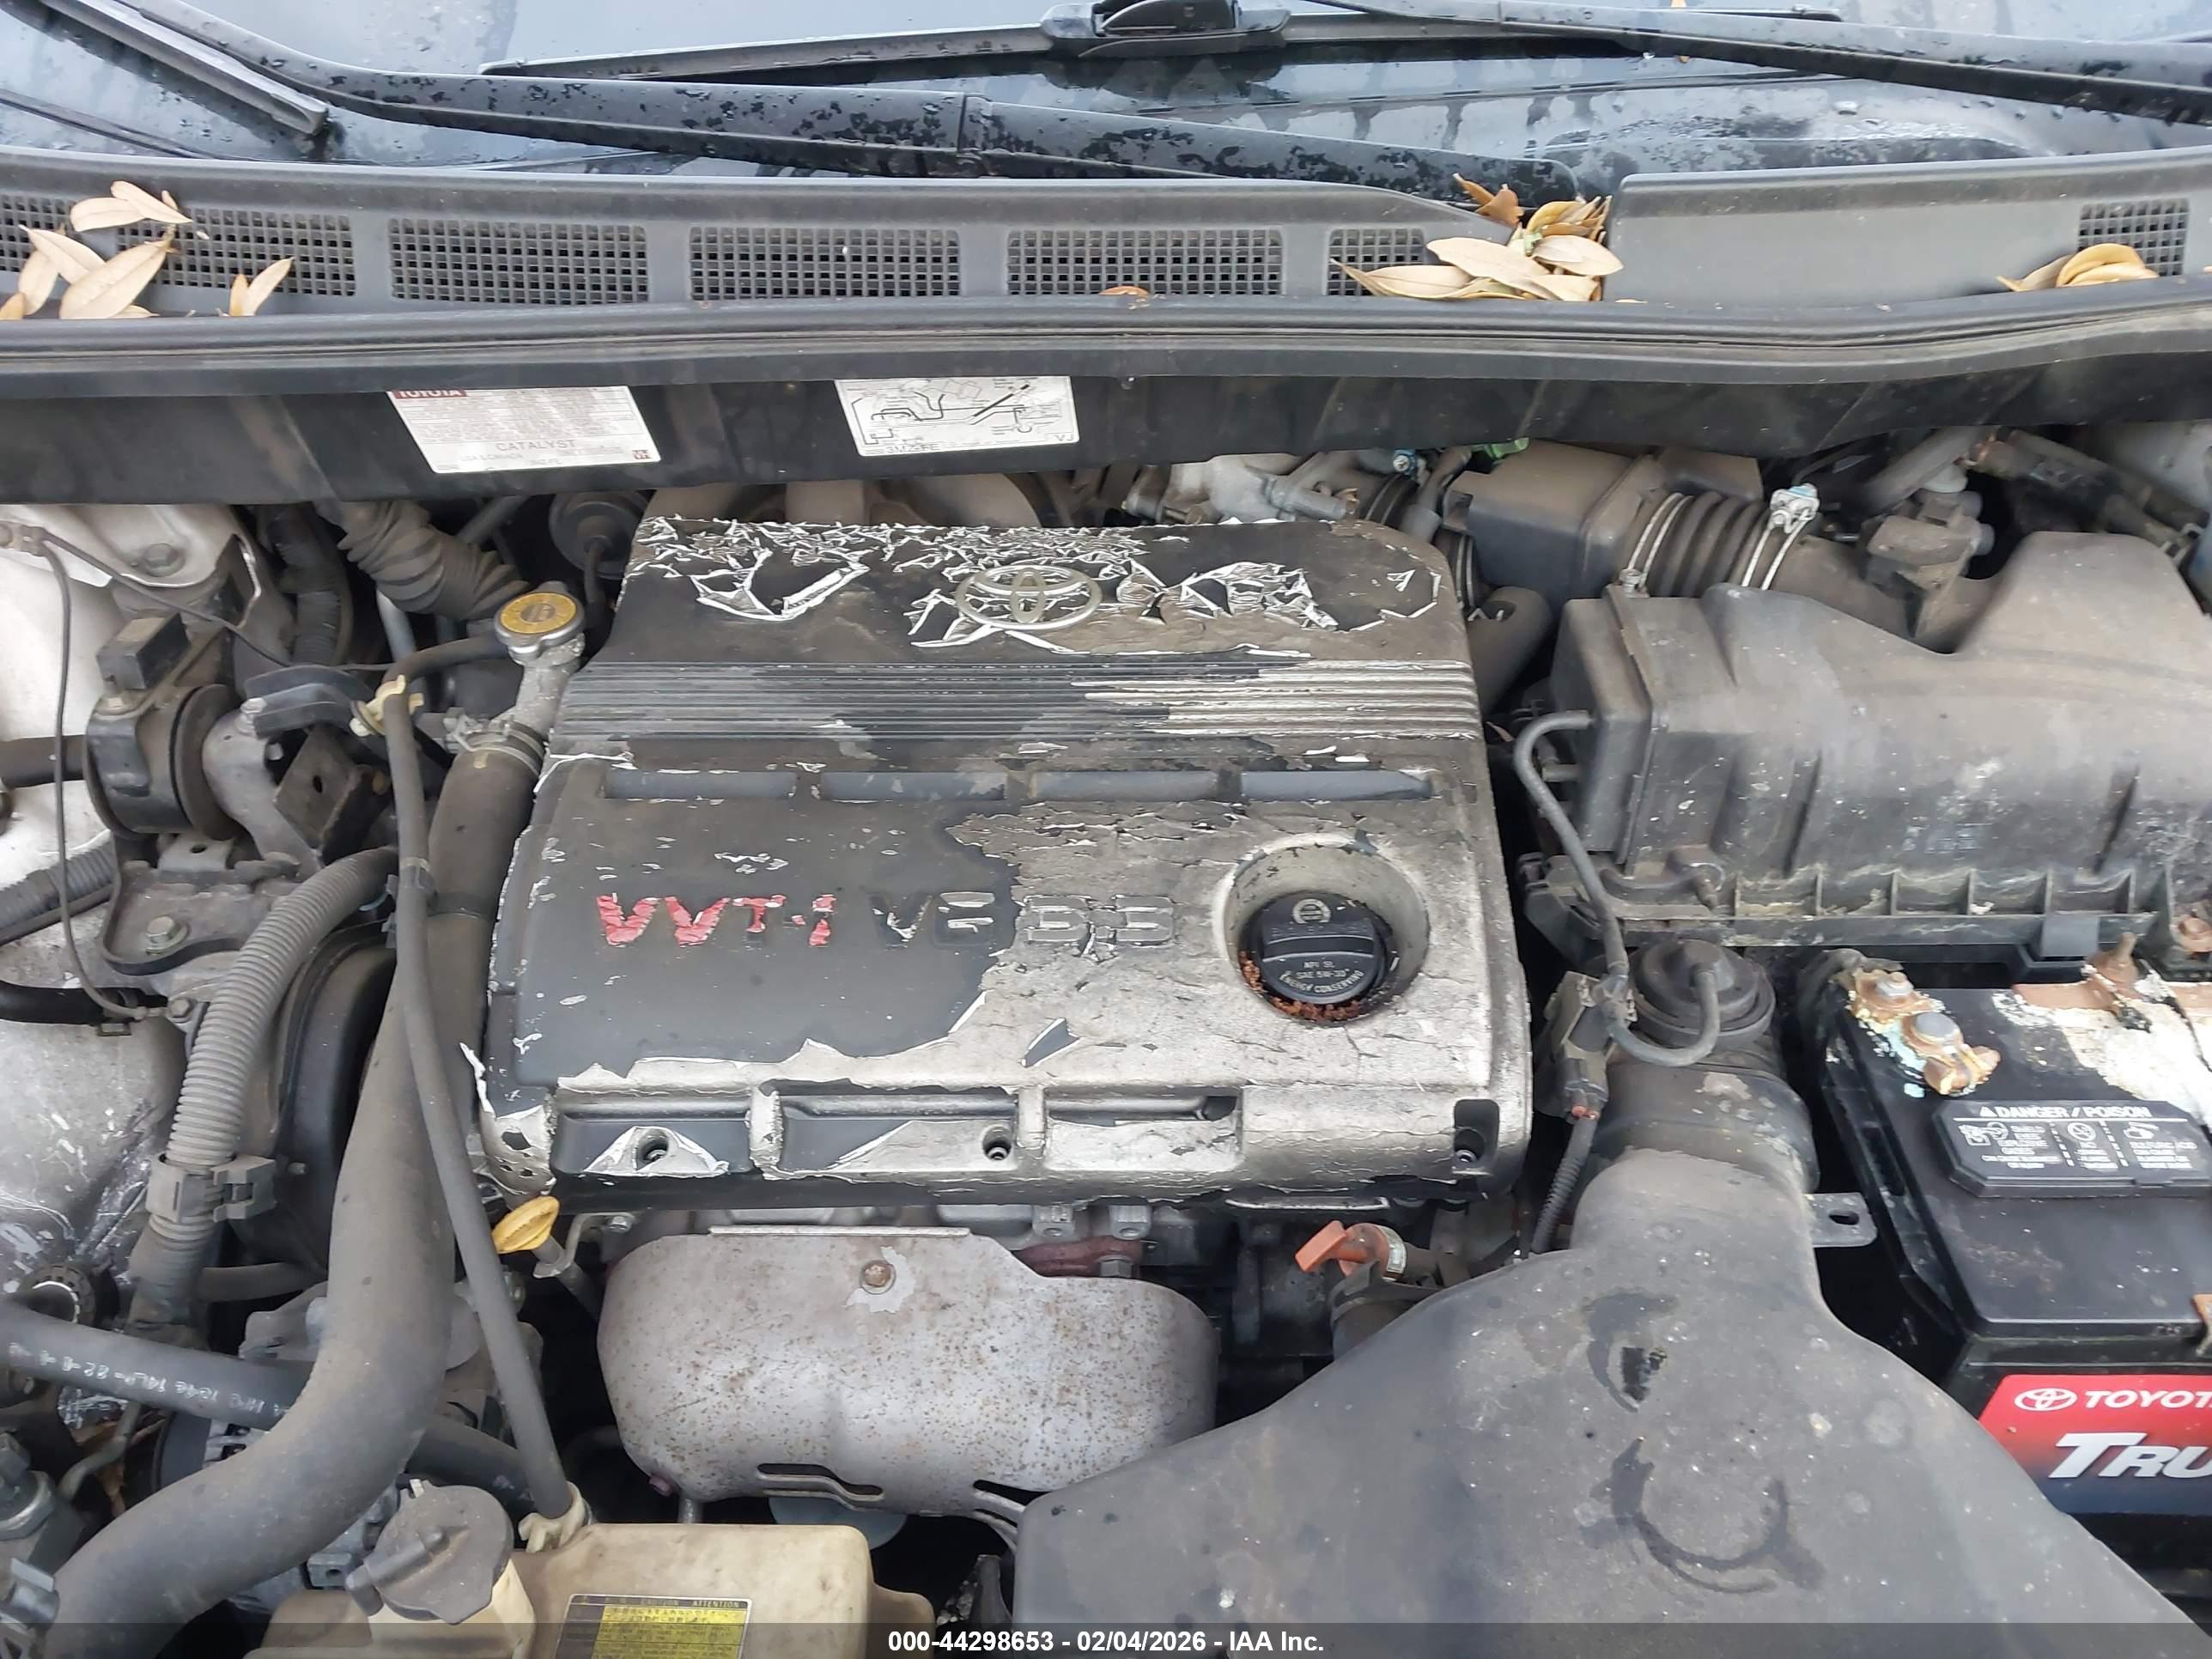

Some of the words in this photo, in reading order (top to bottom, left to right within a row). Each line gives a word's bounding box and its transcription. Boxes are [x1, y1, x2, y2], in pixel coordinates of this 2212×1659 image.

[495, 439, 576, 452] CATALYST
[1995, 1106, 2069, 1118] DANGER
[2086, 1106, 2153, 1119] POISON
[2084, 1389, 2212, 1409] TOYOT
[691, 1600, 740, 1608] ATTENTION
